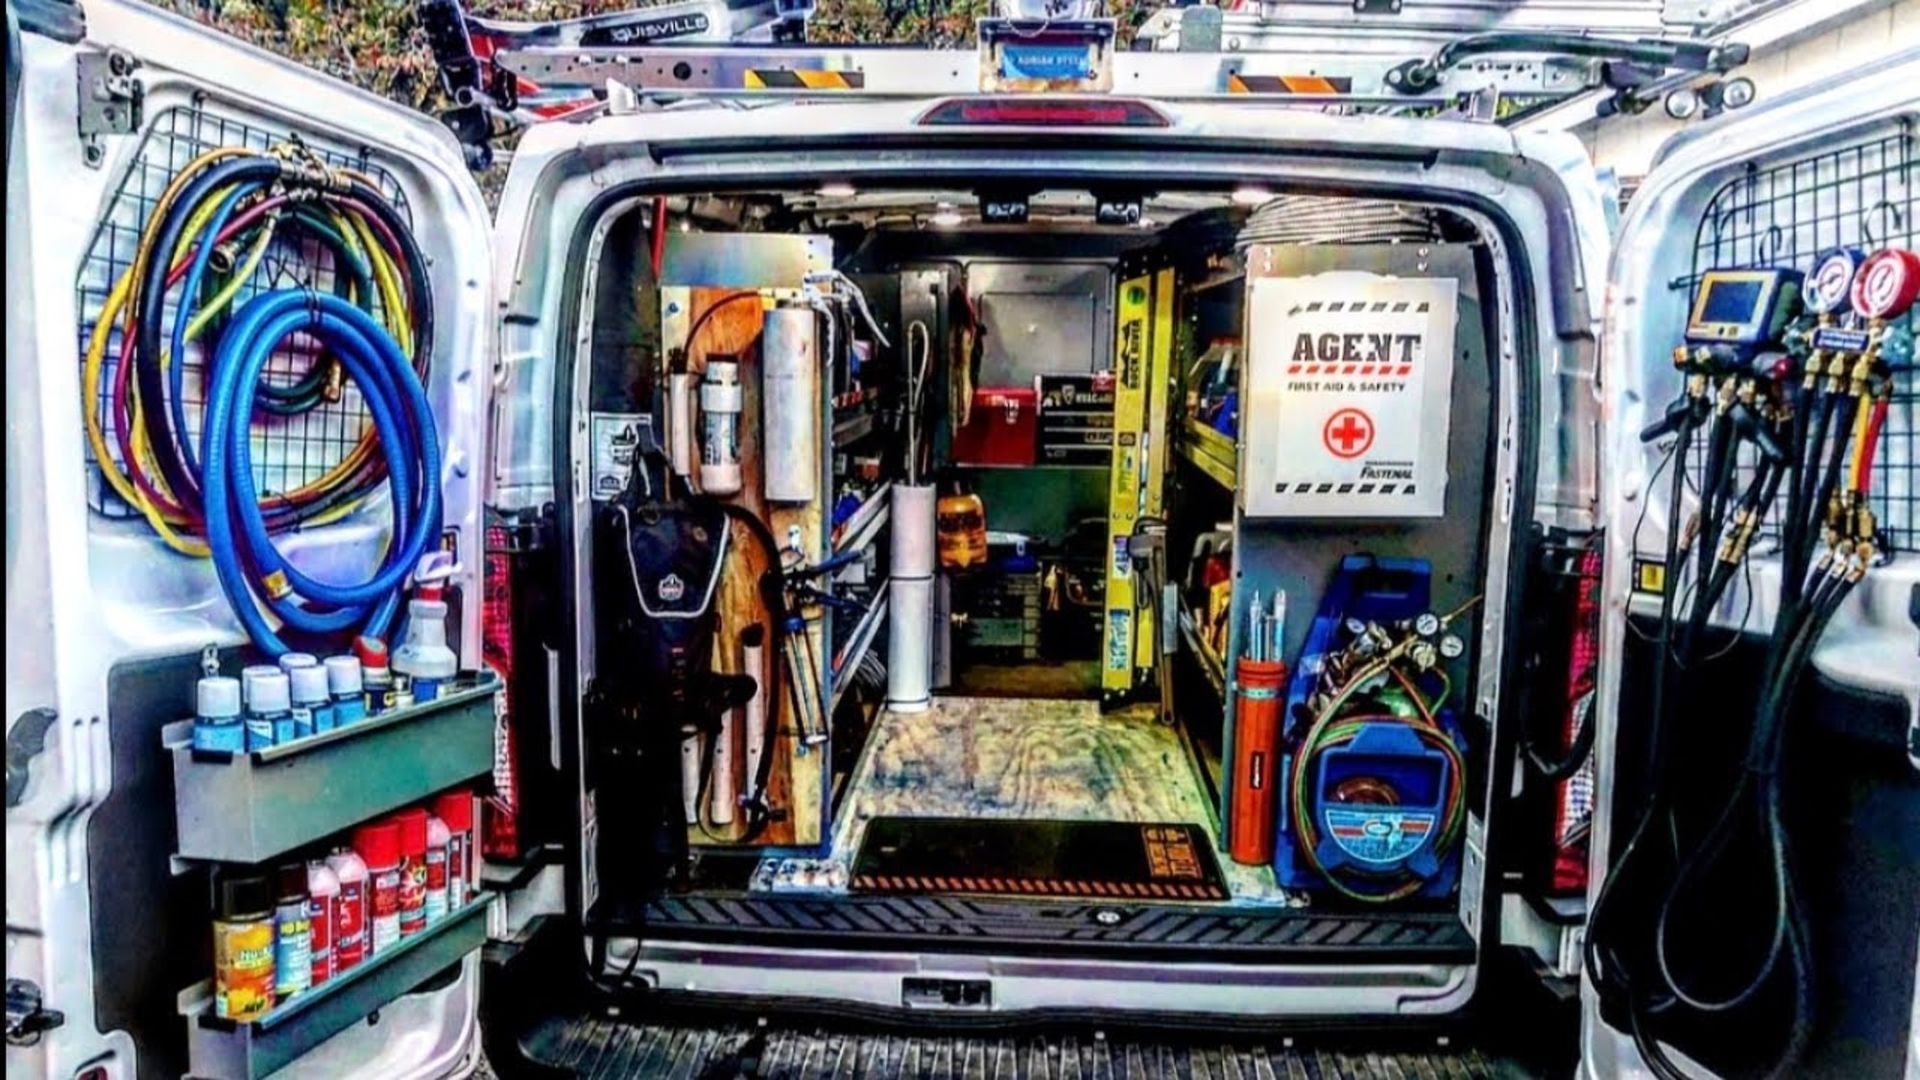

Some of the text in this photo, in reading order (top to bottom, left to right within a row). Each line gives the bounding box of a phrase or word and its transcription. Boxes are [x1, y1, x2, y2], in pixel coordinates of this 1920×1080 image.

[1292, 333, 1421, 362] AGENT
[1288, 382, 1405, 392] FIRST AID & SAFETY
